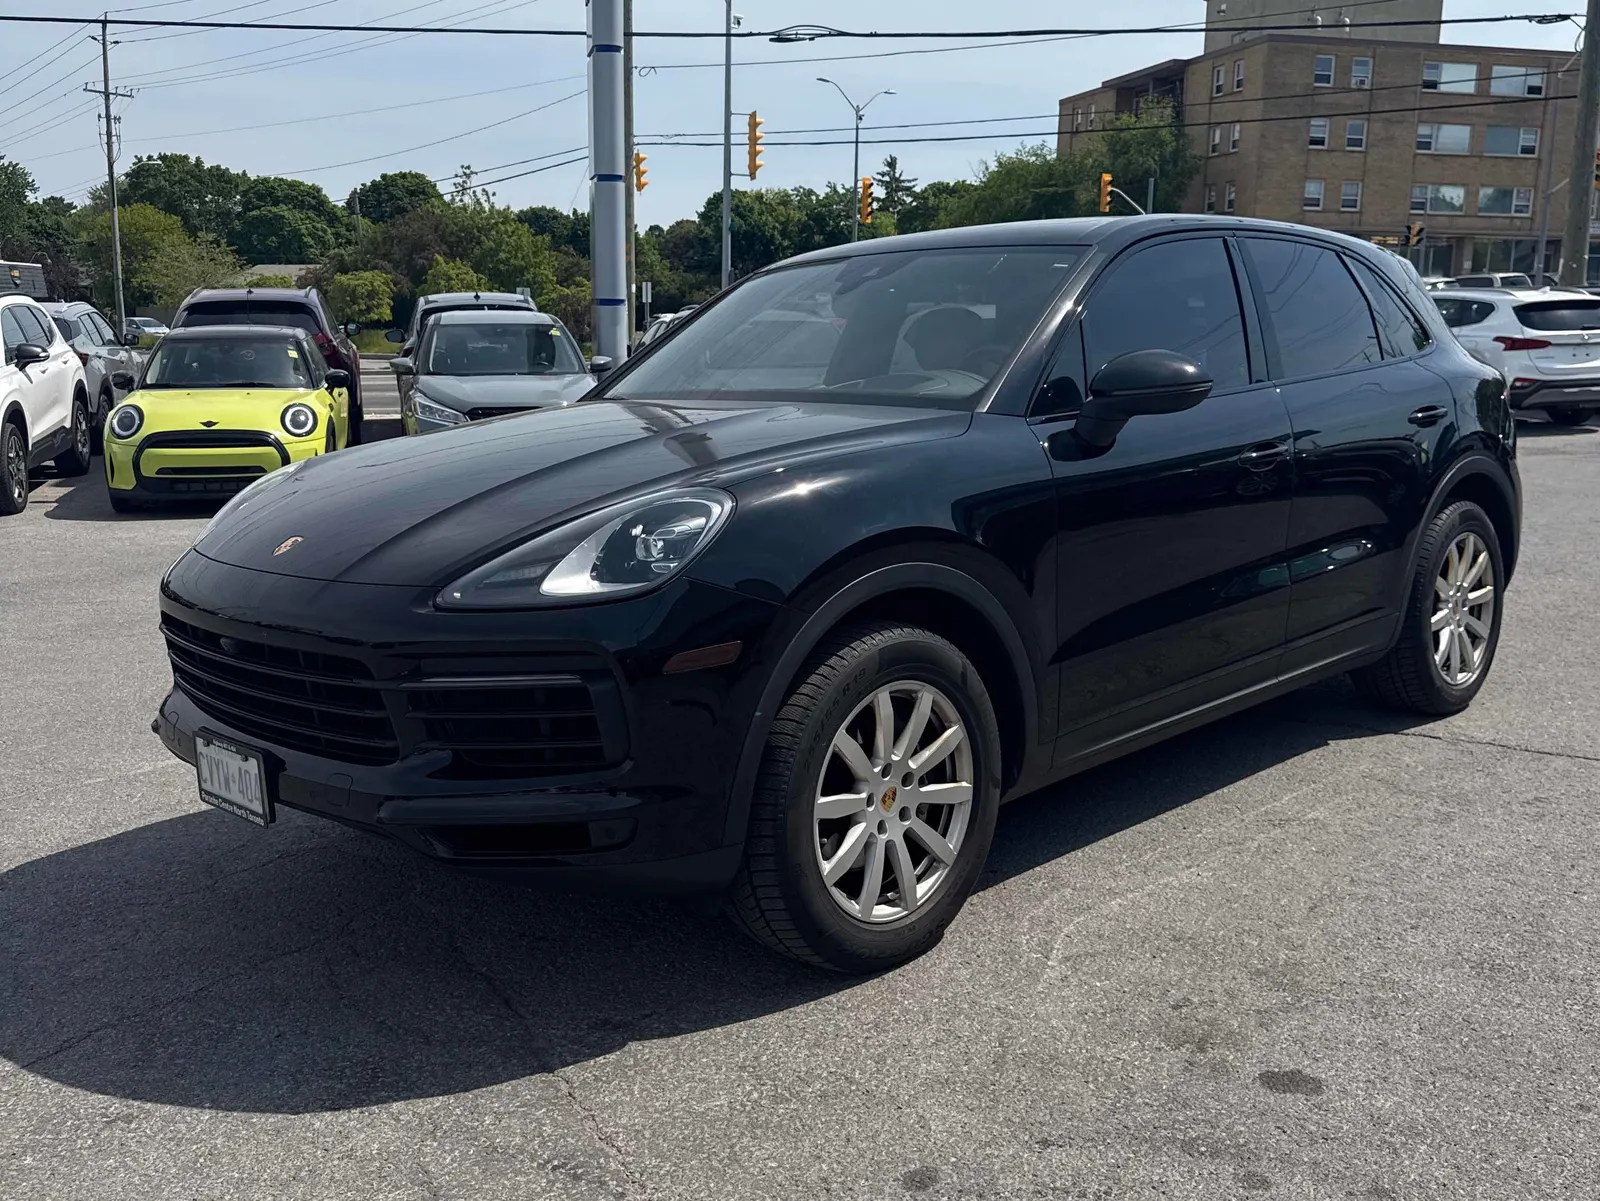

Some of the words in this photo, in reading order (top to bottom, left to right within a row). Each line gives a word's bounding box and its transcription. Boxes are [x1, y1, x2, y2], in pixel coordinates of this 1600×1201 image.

[218, 799, 233, 812] Centre
[233, 806, 246, 819] North
[246, 811, 264, 826] Toronto
